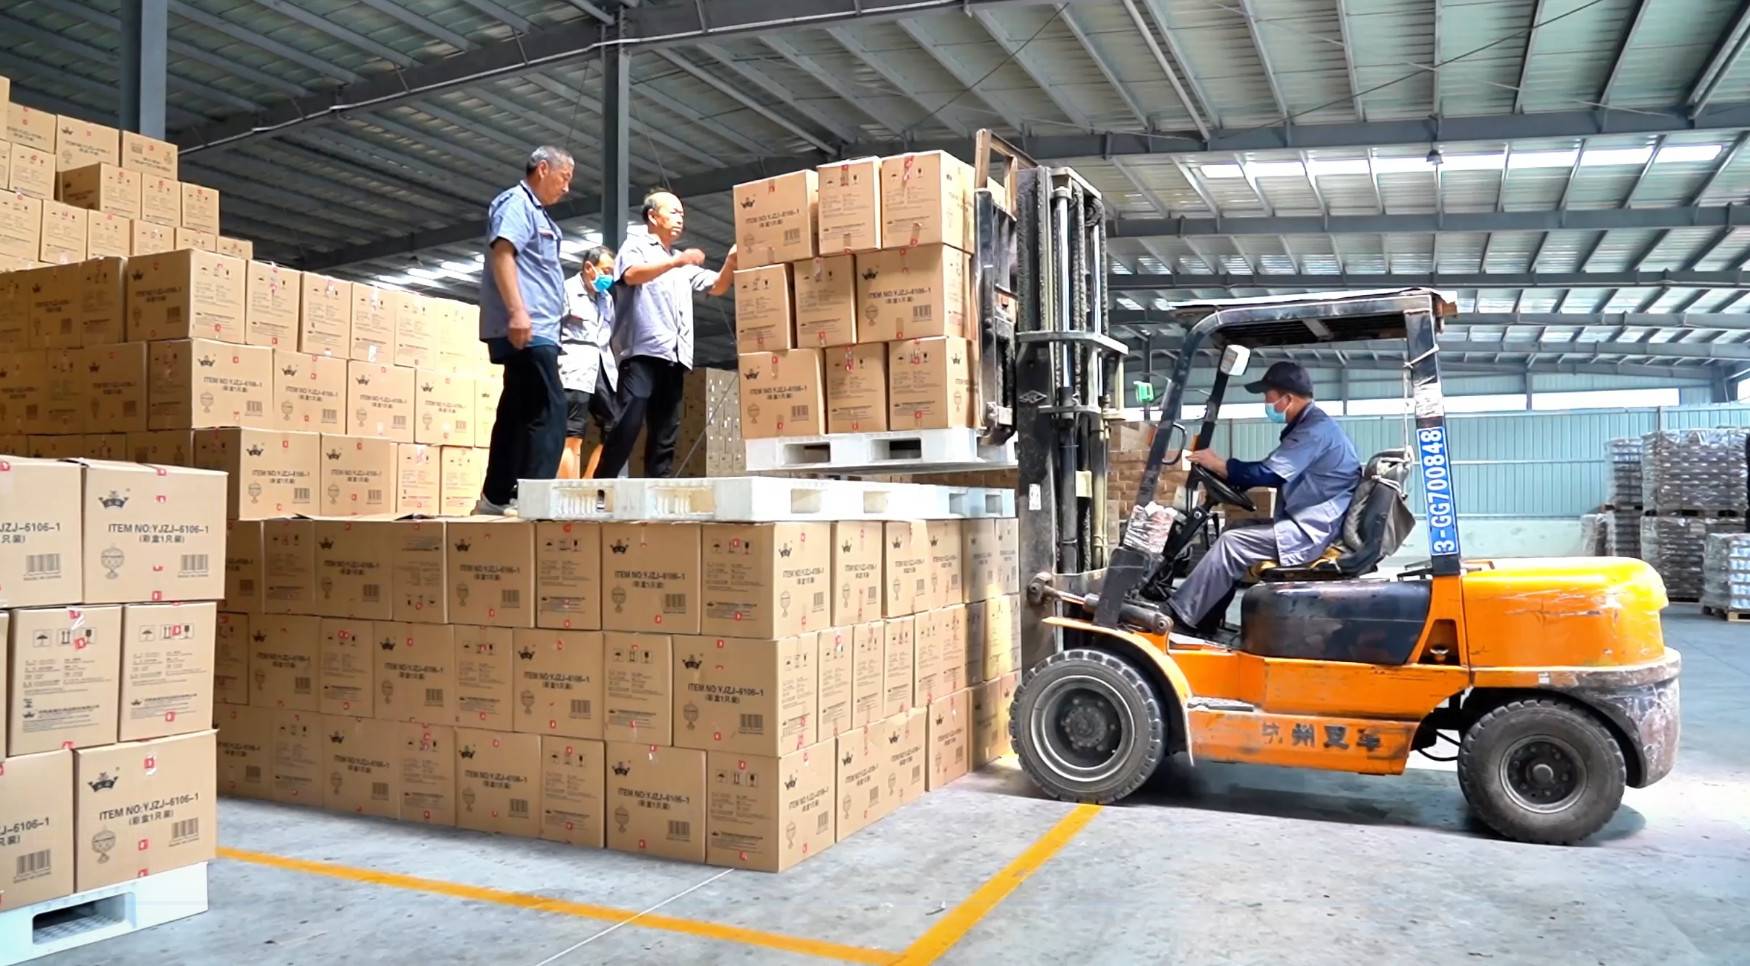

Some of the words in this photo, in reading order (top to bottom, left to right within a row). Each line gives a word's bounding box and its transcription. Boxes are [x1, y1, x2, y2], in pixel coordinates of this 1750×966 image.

[1420, 429, 1455, 552] 3-GG700848
[108, 524, 132, 533] ITEM
[99, 808, 124, 821] ITEM
